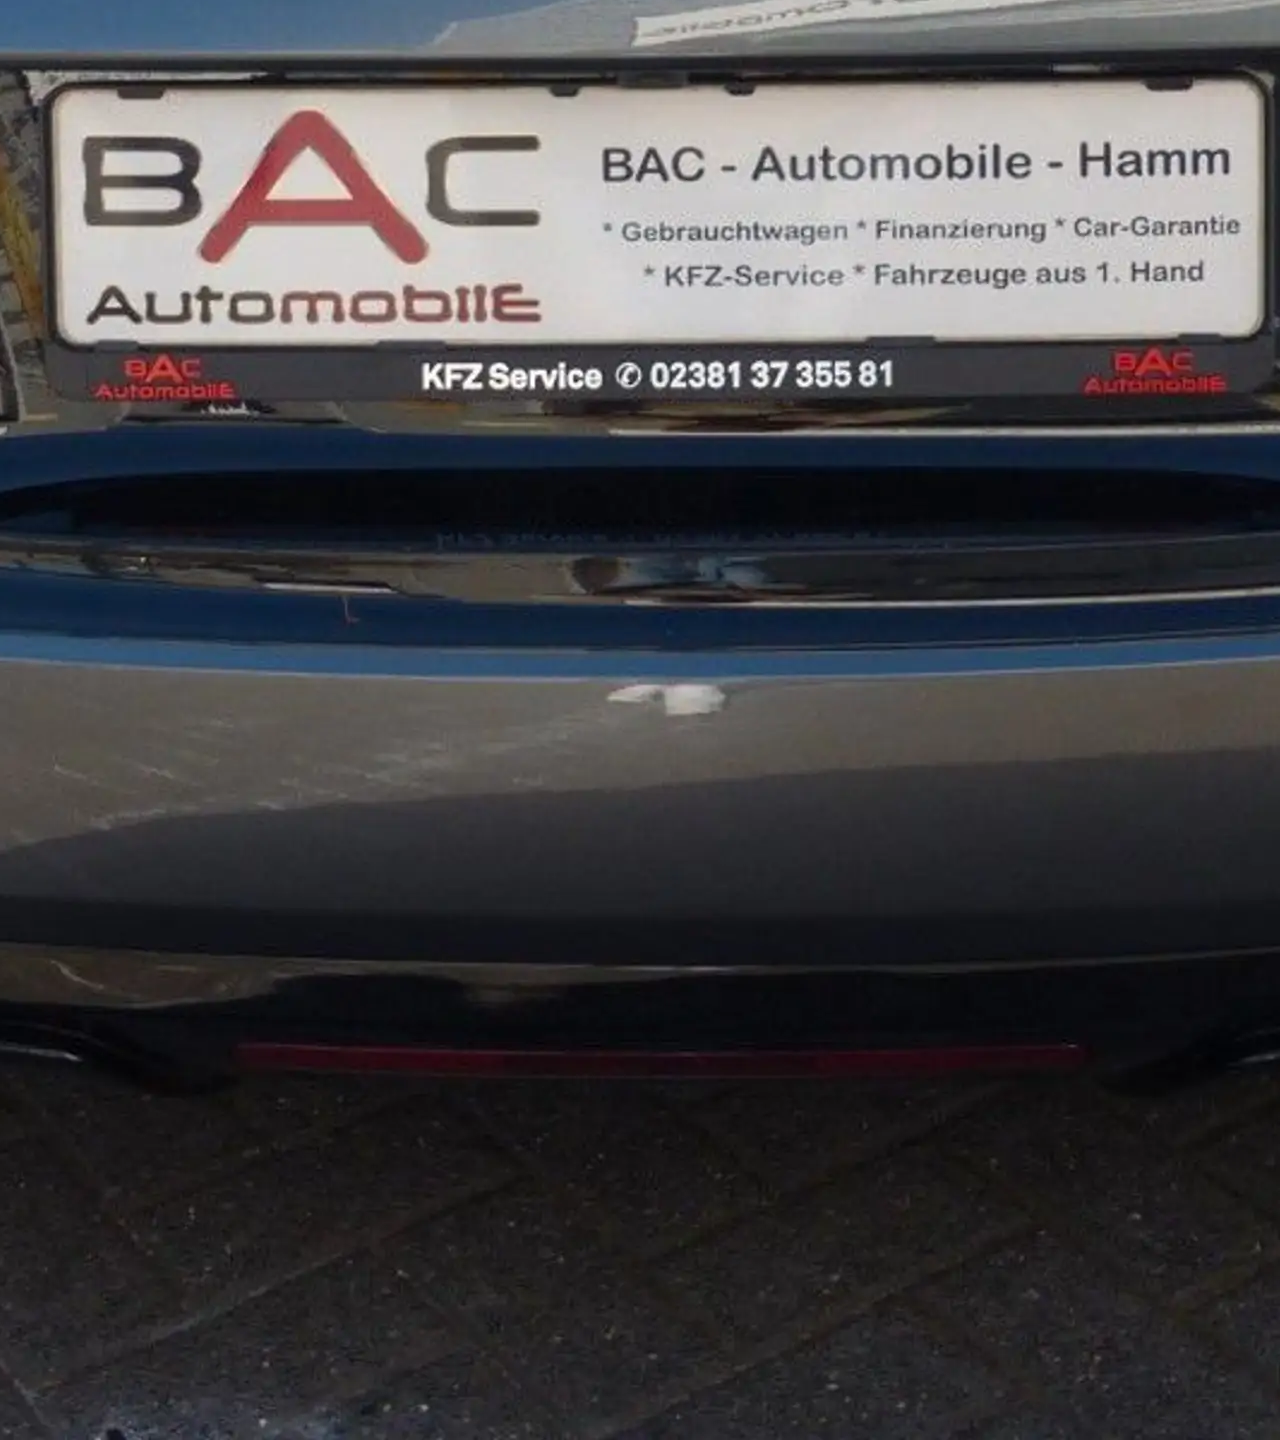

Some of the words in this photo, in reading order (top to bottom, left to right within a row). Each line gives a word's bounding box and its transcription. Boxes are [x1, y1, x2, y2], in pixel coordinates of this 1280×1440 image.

[602, 146, 705, 183] BAC
[751, 143, 1032, 182] Automobile
[1078, 141, 1231, 178] Hamm
[81, 109, 541, 265] BAC
[621, 220, 849, 246] Gebrauchtwagen
[875, 218, 1048, 244] Finanzierung
[1073, 215, 1241, 239] Car-Garantie
[664, 262, 846, 288] KFZ-Service
[874, 262, 1027, 289] Fahrzeuge
[1035, 265, 1087, 285] aus
[1095, 261, 1121, 284] 1.
[1131, 260, 1205, 283] Hand
[124, 352, 202, 383] BAC
[421, 361, 484, 391] KFZ
[488, 361, 604, 391] Service
[650, 361, 742, 389] 02381
[751, 360, 787, 388] 37
[795, 359, 852, 388] 355
[858, 359, 894, 387] 81
[1114, 347, 1196, 377] BAC
